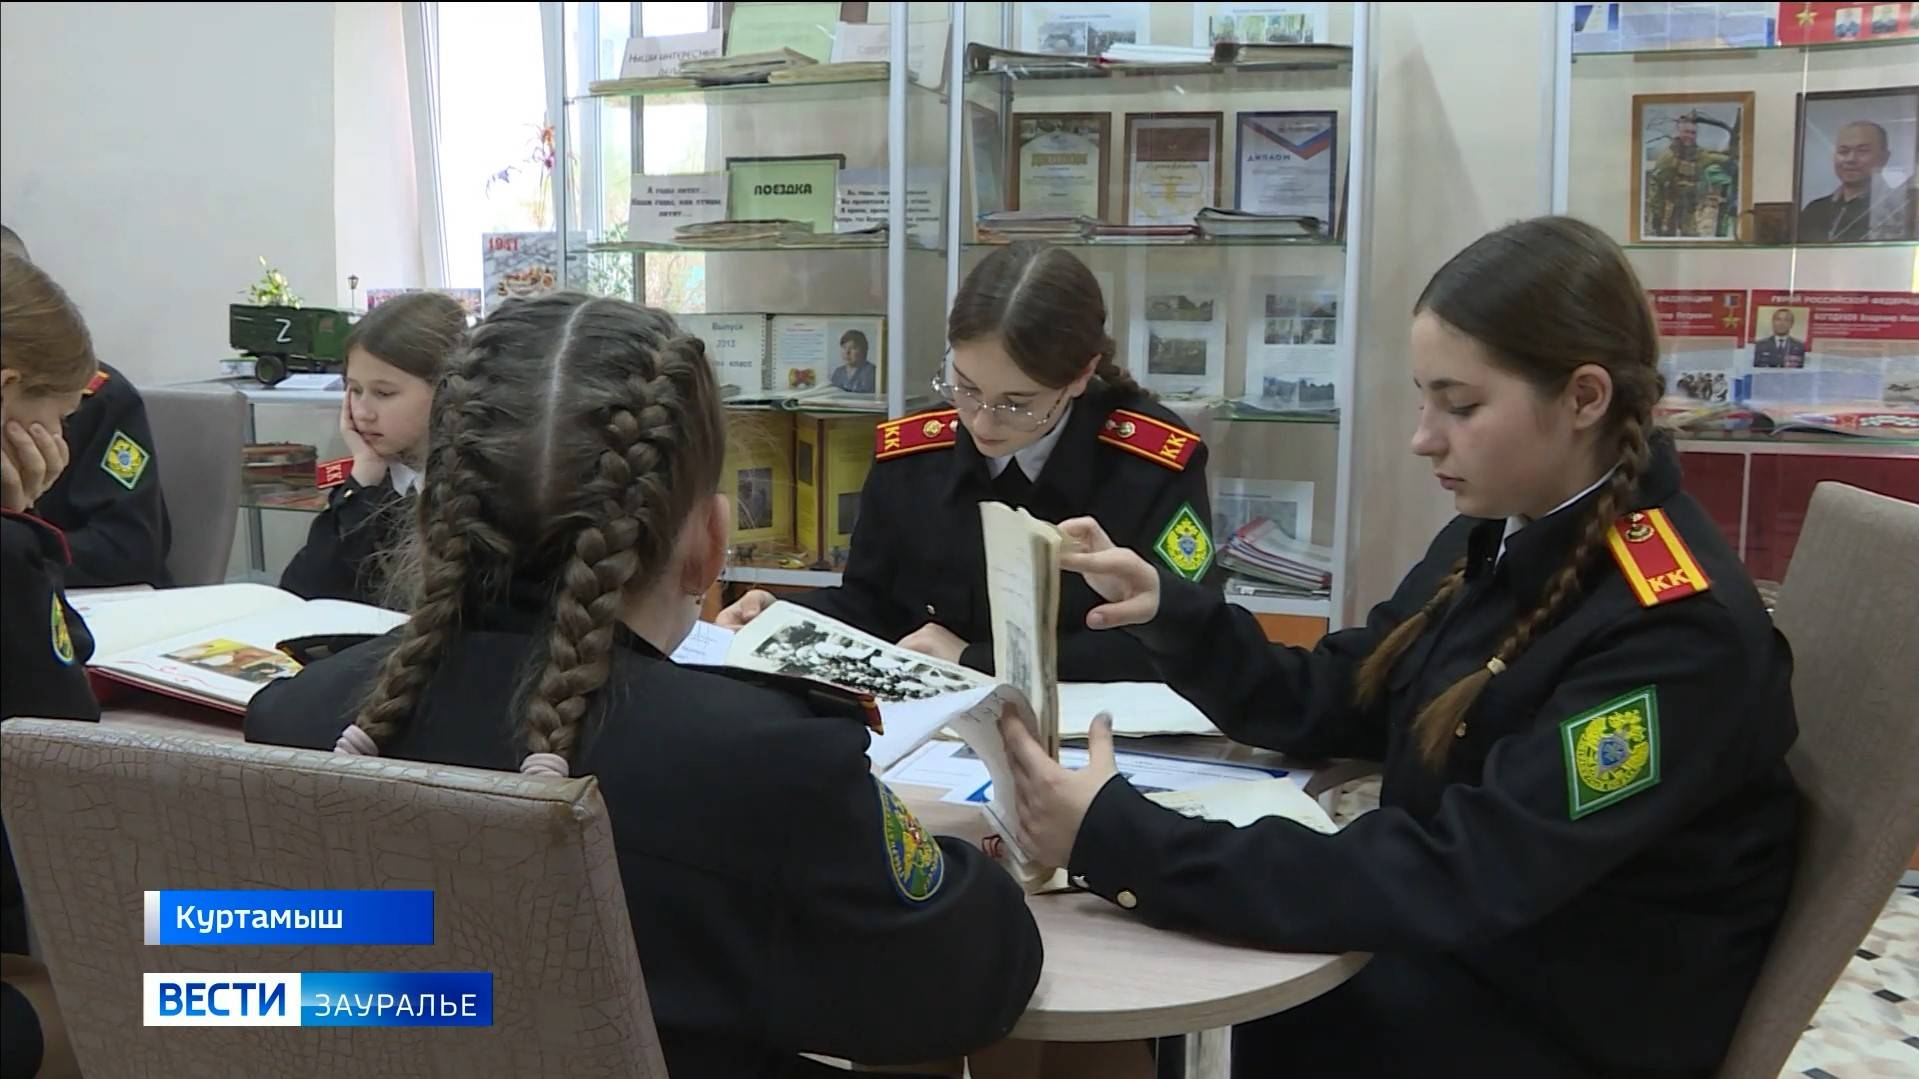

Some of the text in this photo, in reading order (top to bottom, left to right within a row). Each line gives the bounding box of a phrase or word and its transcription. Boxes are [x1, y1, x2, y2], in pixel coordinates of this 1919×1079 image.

[1247, 153, 1291, 162] ДИПЛОМ
[753, 183, 813, 196] ПОЕЗДКА
[489, 237, 519, 251] 1941
[275, 318, 291, 342] Z
[884, 425, 900, 451] КК
[1160, 433, 1188, 460] КК
[1647, 569, 1690, 592] КК
